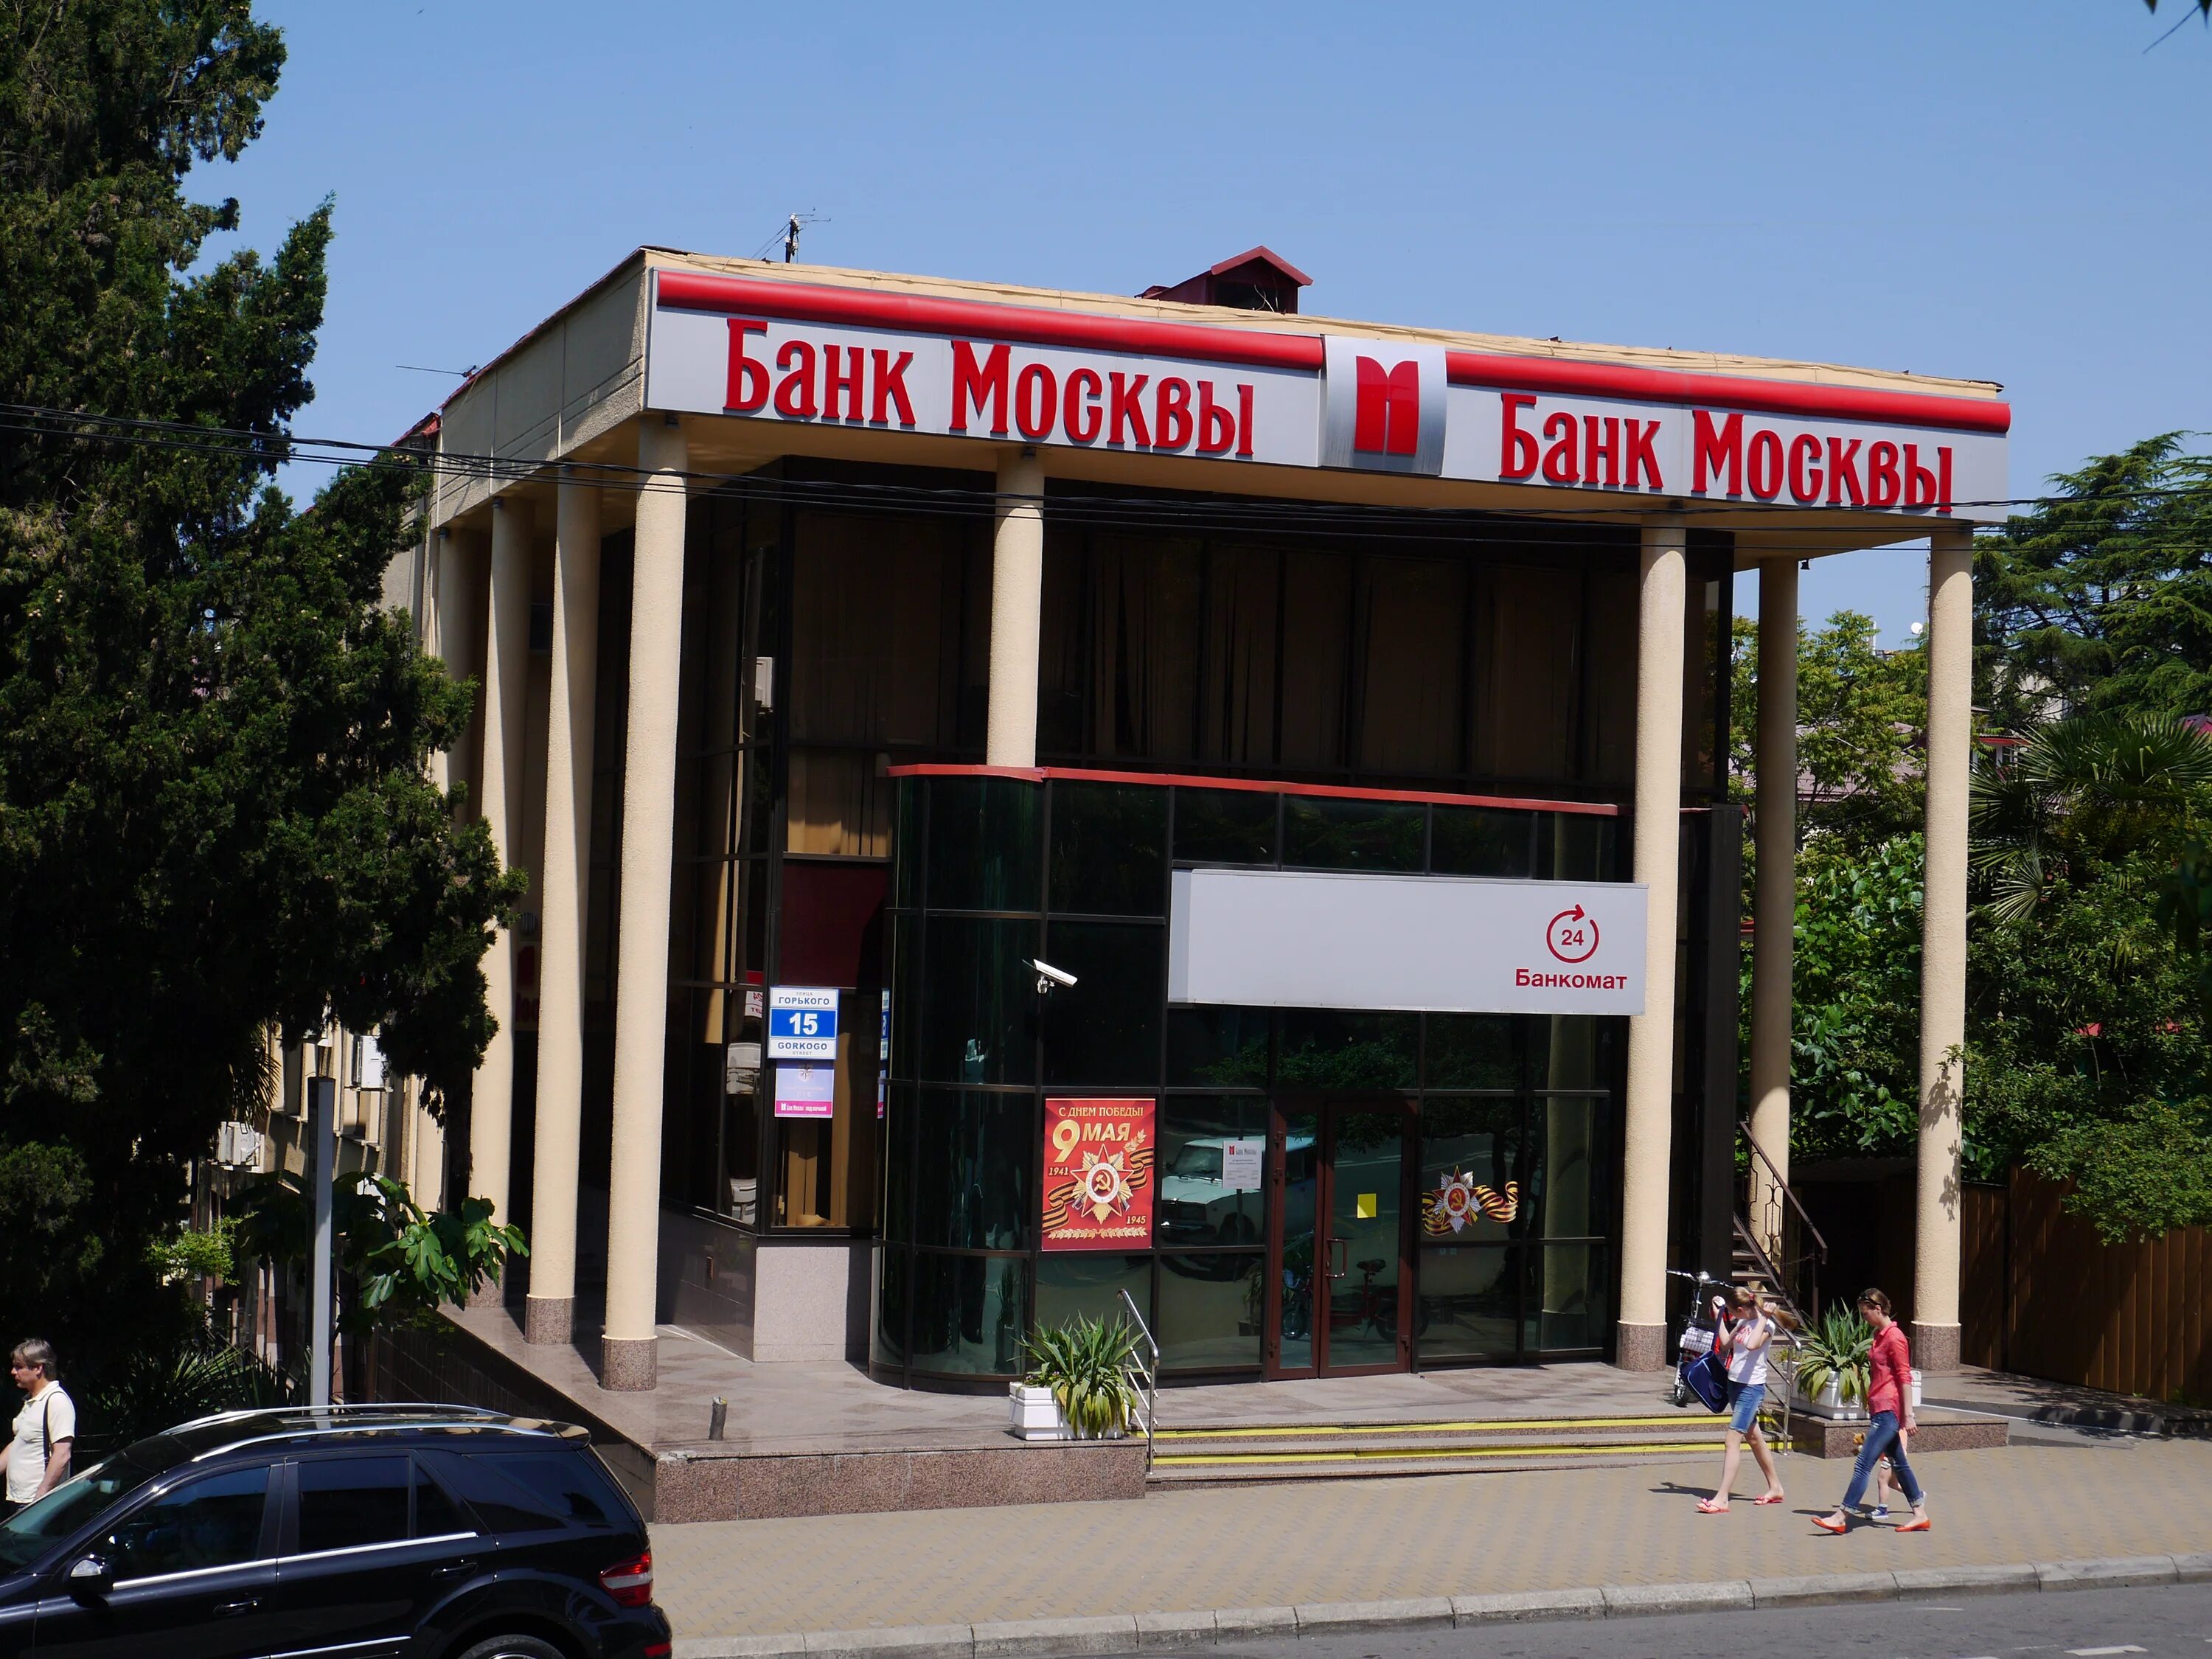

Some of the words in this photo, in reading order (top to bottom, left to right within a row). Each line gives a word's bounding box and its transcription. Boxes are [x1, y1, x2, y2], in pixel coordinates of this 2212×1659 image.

[723, 318, 916, 425] Банк
[949, 339, 1254, 456] Москвы
[1498, 392, 1664, 490] Банк
[1691, 409, 1952, 514] Москвы
[1561, 929, 1584, 946] 24
[1515, 967, 1627, 990] Банкомат
[779, 997, 830, 1005] ГОРЬКОГО
[789, 1012, 818, 1035] 15
[778, 1043, 827, 1051] GORKOGO
[1059, 1107, 1066, 1116] С
[1068, 1107, 1096, 1118] ДНЕМ
[1099, 1107, 1144, 1118] ПОБЕДЫ!
[1052, 1119, 1081, 1163] 9
[1082, 1122, 1131, 1141] МАЯ
[1048, 1167, 1069, 1176] 1941
[1126, 1215, 1147, 1225] 1945
